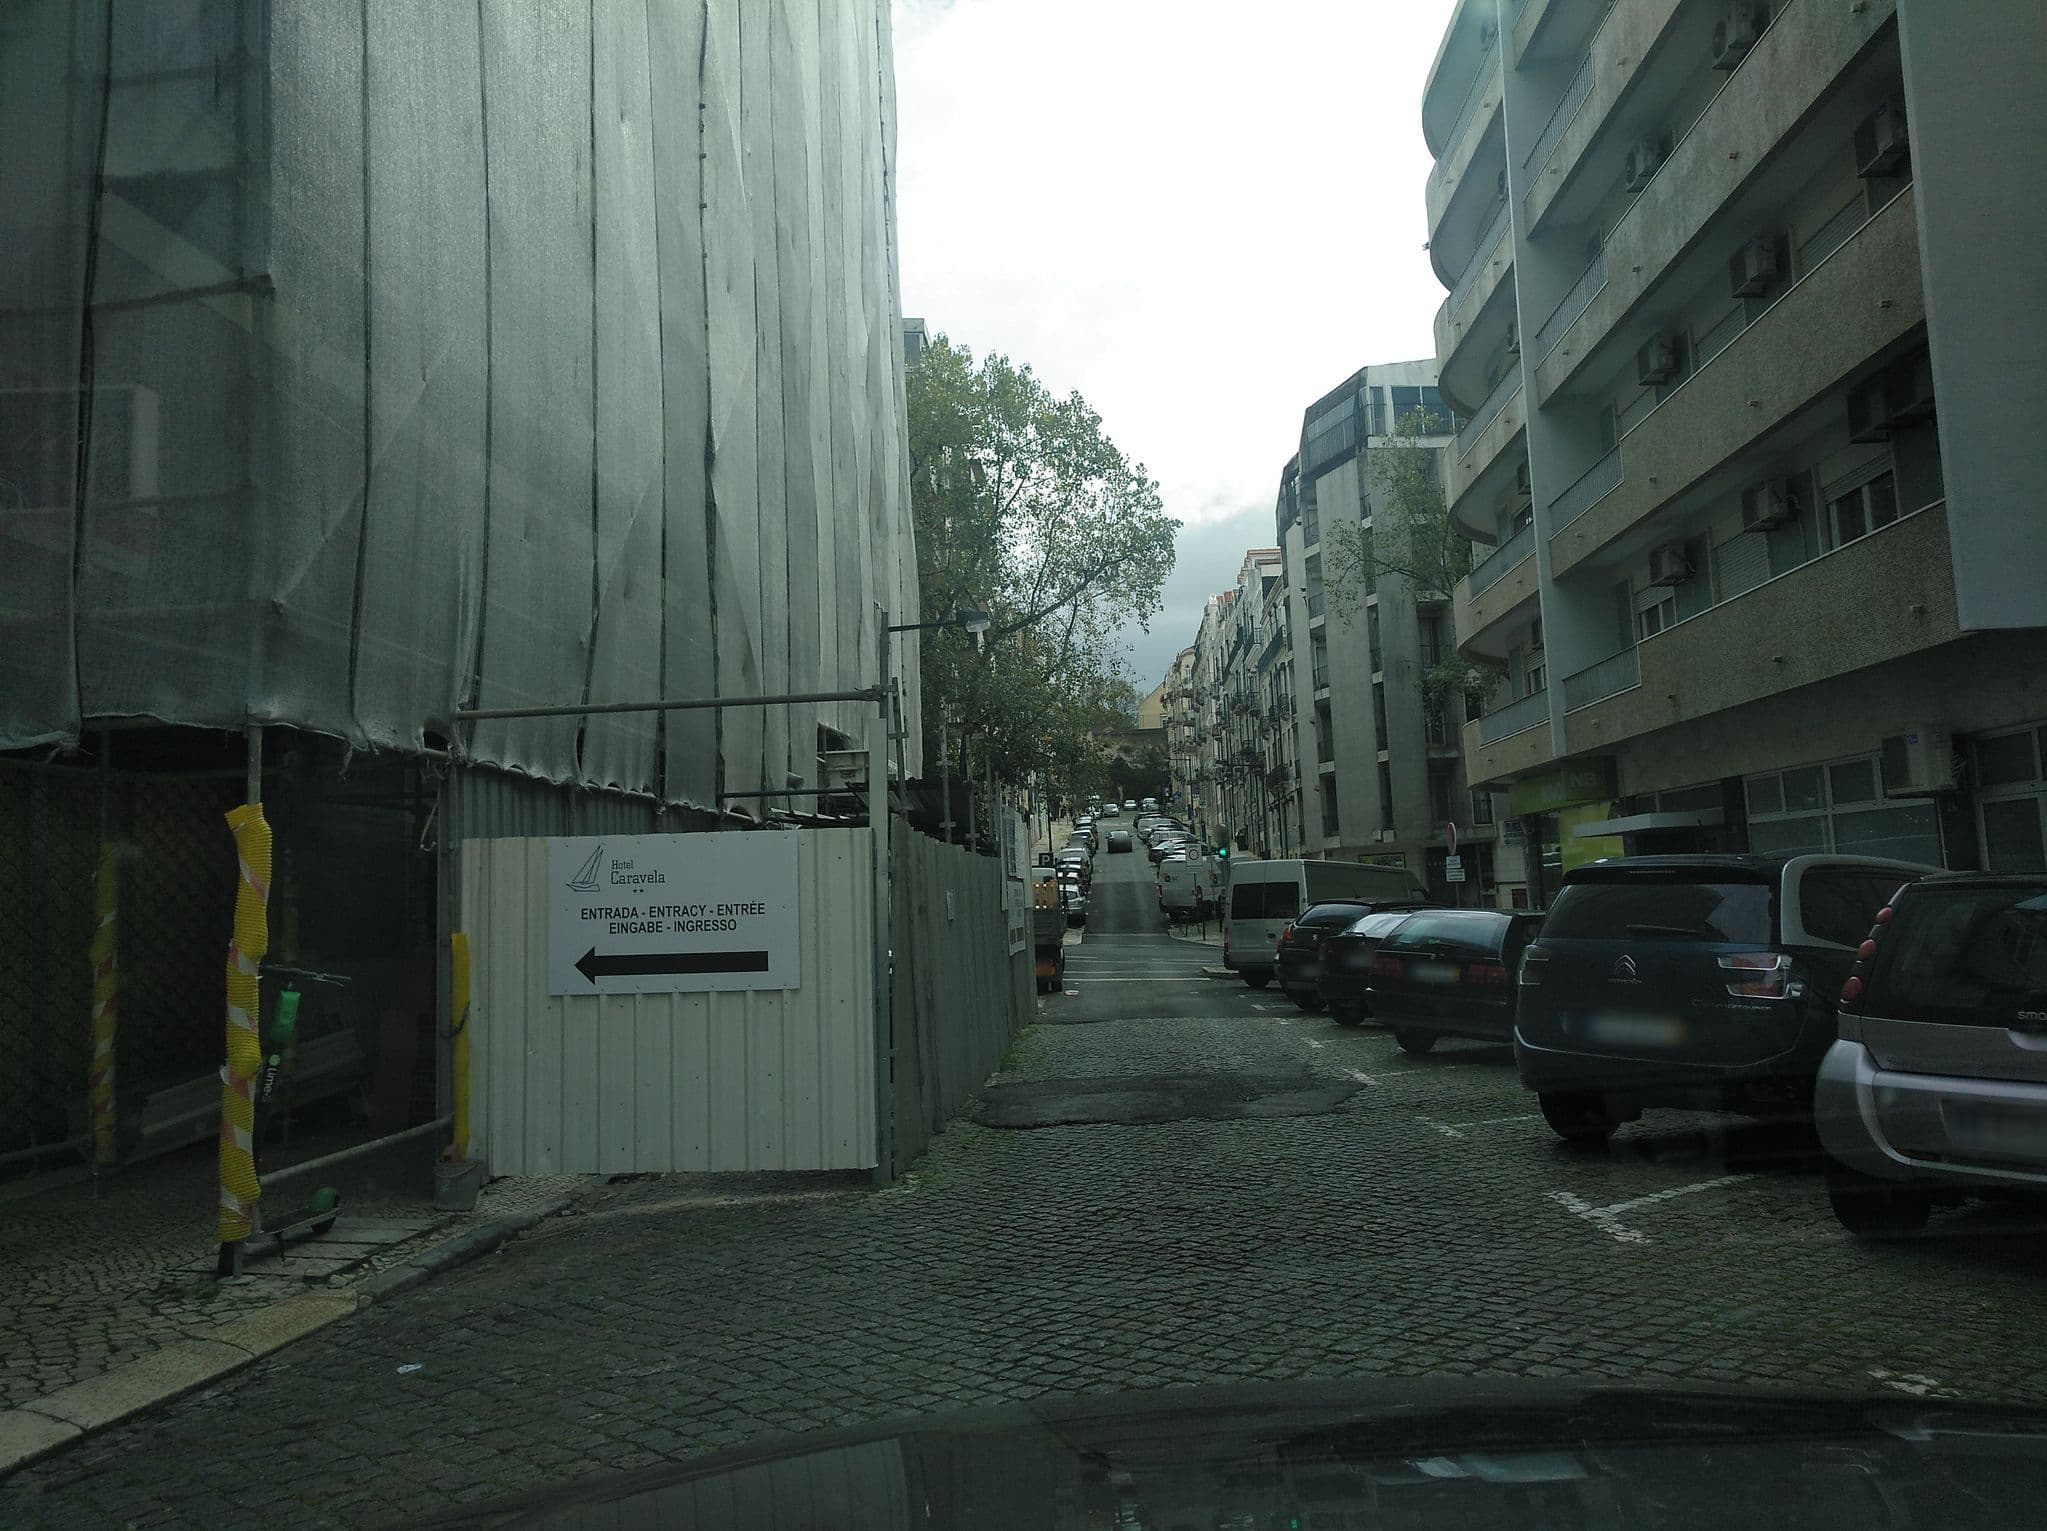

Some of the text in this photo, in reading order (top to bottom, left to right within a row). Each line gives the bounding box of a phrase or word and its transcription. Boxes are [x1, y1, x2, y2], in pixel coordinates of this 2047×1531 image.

[612, 859, 634, 870] Hotel
[1041, 854, 1050, 866] P
[611, 870, 666, 885] Caravela
[581, 906, 639, 920] ENTRADA
[649, 904, 707, 918] ENTRACY
[717, 900, 766, 917] ENTRÉE
[609, 921, 663, 935] EINGABE
[673, 919, 737, 933] INGRESSO
